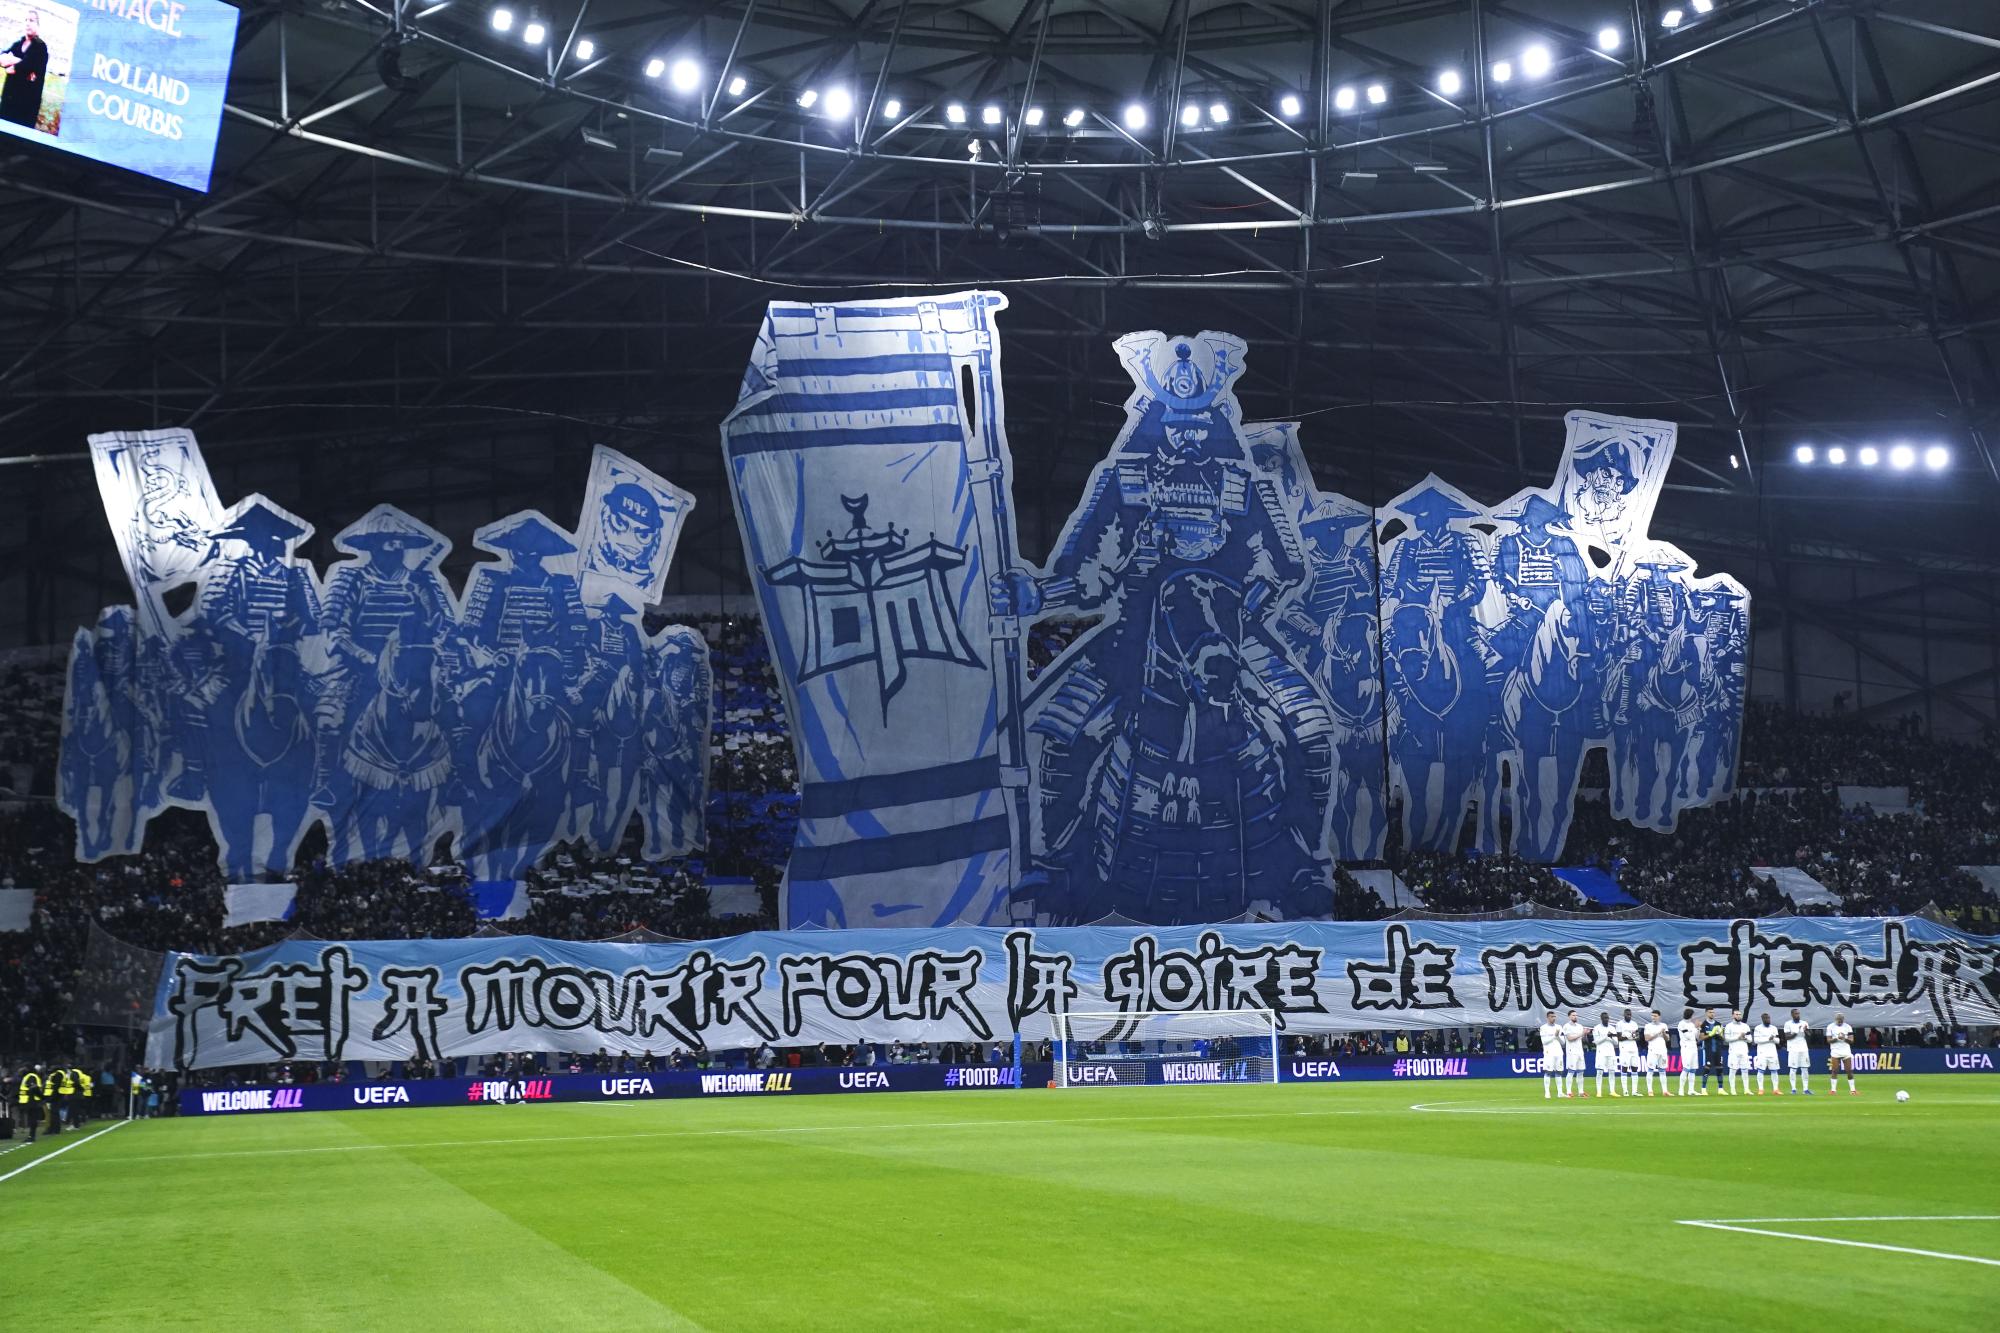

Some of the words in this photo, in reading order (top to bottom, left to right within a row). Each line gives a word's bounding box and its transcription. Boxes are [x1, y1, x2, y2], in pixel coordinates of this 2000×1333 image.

[92, 53, 190, 106] ROLLAND
[87, 89, 183, 141] COURBIS
[622, 495, 648, 518] 1992
[372, 966, 448, 1060] A
[1292, 1061, 1341, 1077] UEFA
[1392, 1057, 1468, 1076] #FOOTBALL
[1511, 1058, 1545, 1074] UEF
[1945, 1053, 1994, 1069] UEFA
[839, 1071, 890, 1089] UEFA
[944, 1067, 1023, 1087] #FOOTBAL
[1069, 1066, 1118, 1082] UEFA
[1162, 1063, 1221, 1081] WELCOME
[601, 1078, 655, 1095] UEFA
[701, 1074, 764, 1093] WELCOME
[765, 1073, 793, 1091] ALL
[202, 1091, 272, 1112] WELCOME
[272, 1088, 303, 1108] ALL
[353, 1086, 410, 1104] UEFA
